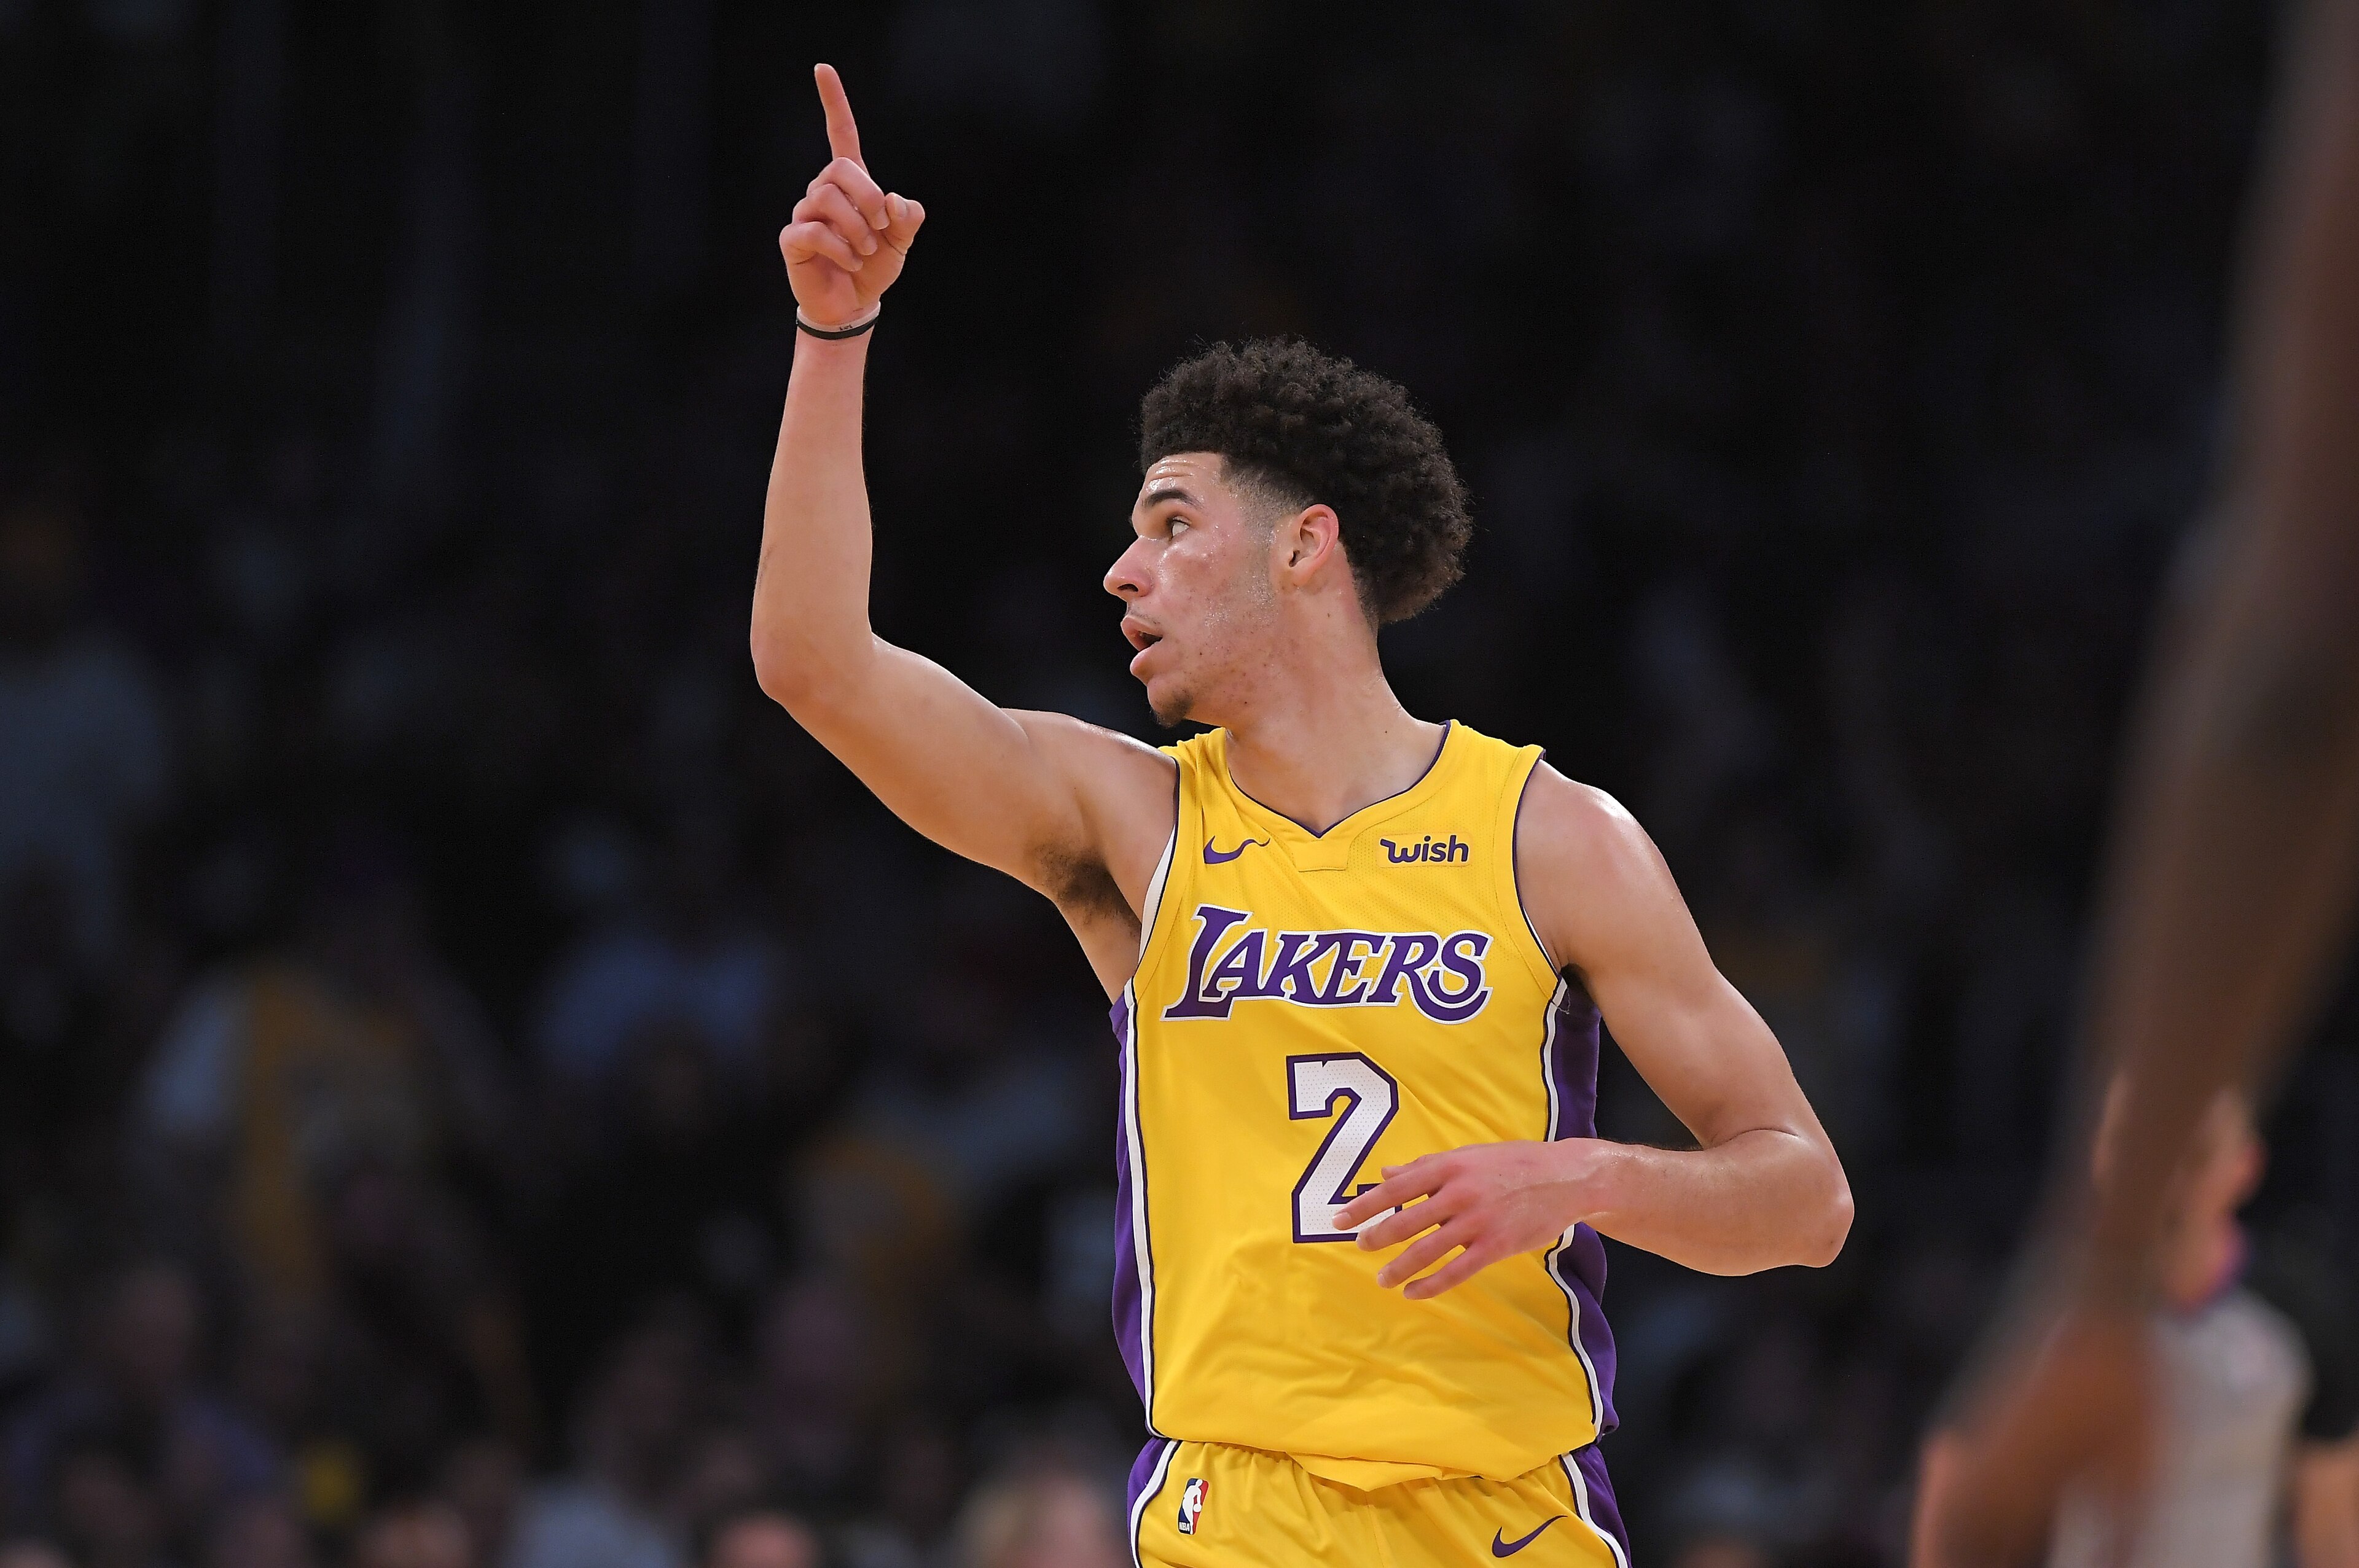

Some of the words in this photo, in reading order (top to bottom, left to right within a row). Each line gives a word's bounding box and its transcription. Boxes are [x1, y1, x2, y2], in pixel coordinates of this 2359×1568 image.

[1380, 835, 1469, 863] wish
[1160, 903, 1494, 1025] LAKERS
[1286, 1051, 1402, 1244] 2
[1179, 1521, 1190, 1532] NBA
